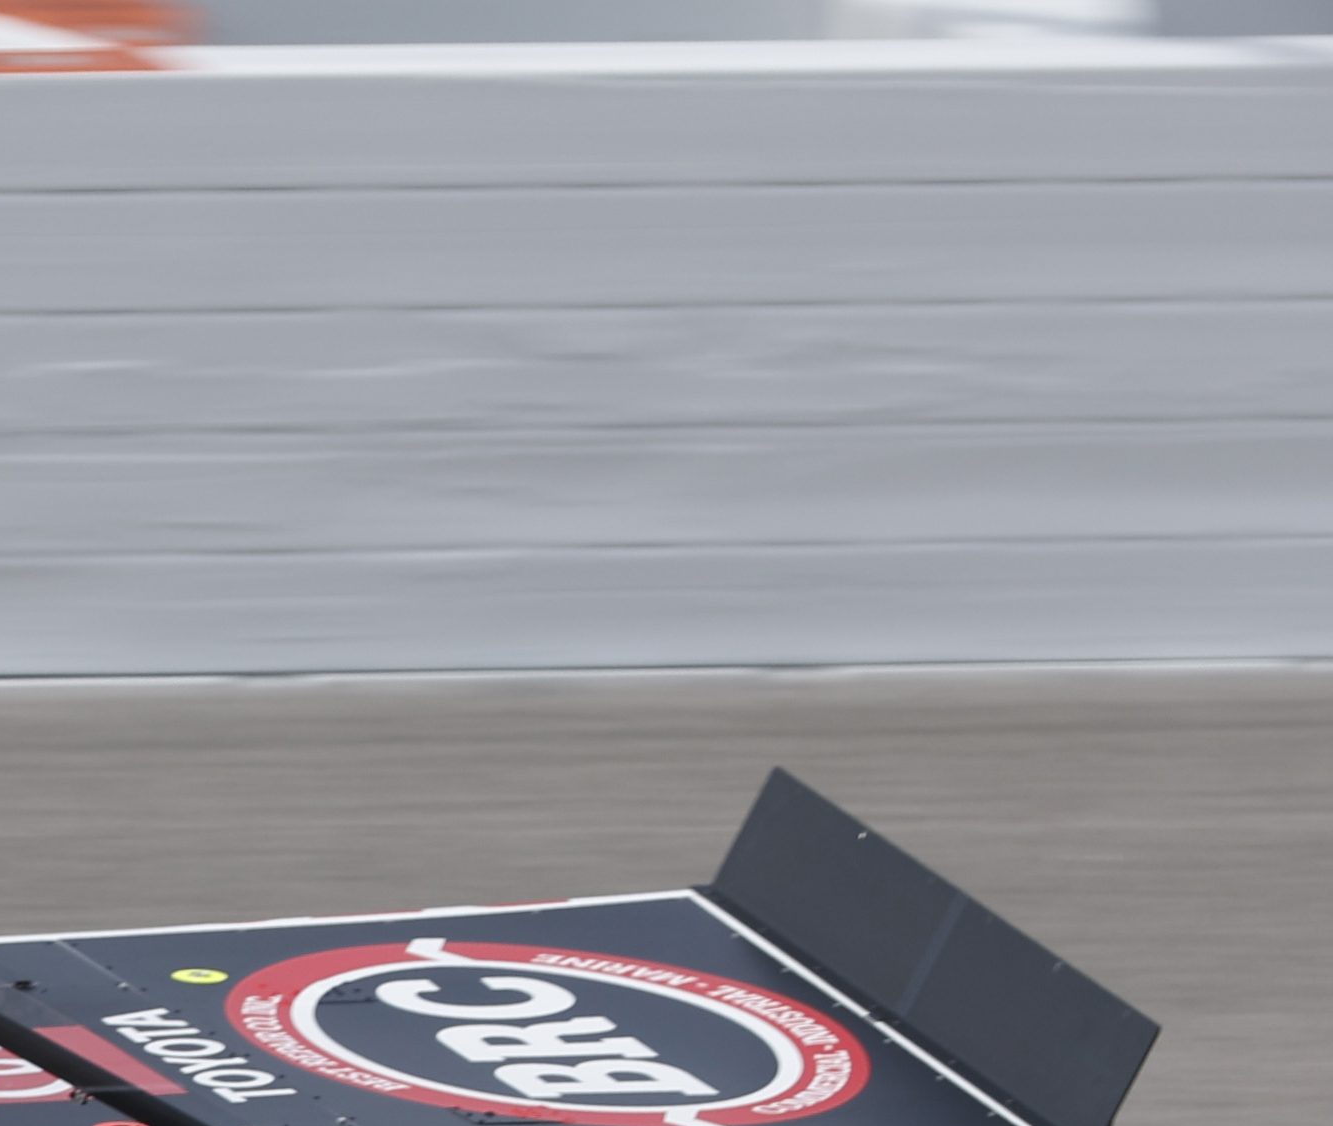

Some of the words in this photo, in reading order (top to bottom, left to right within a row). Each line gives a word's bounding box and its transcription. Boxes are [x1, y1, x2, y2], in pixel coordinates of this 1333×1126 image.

[530, 953, 701, 987] MARINE
[101, 1007, 298, 1103] TOYOTA
[375, 976, 720, 1099] BRC
